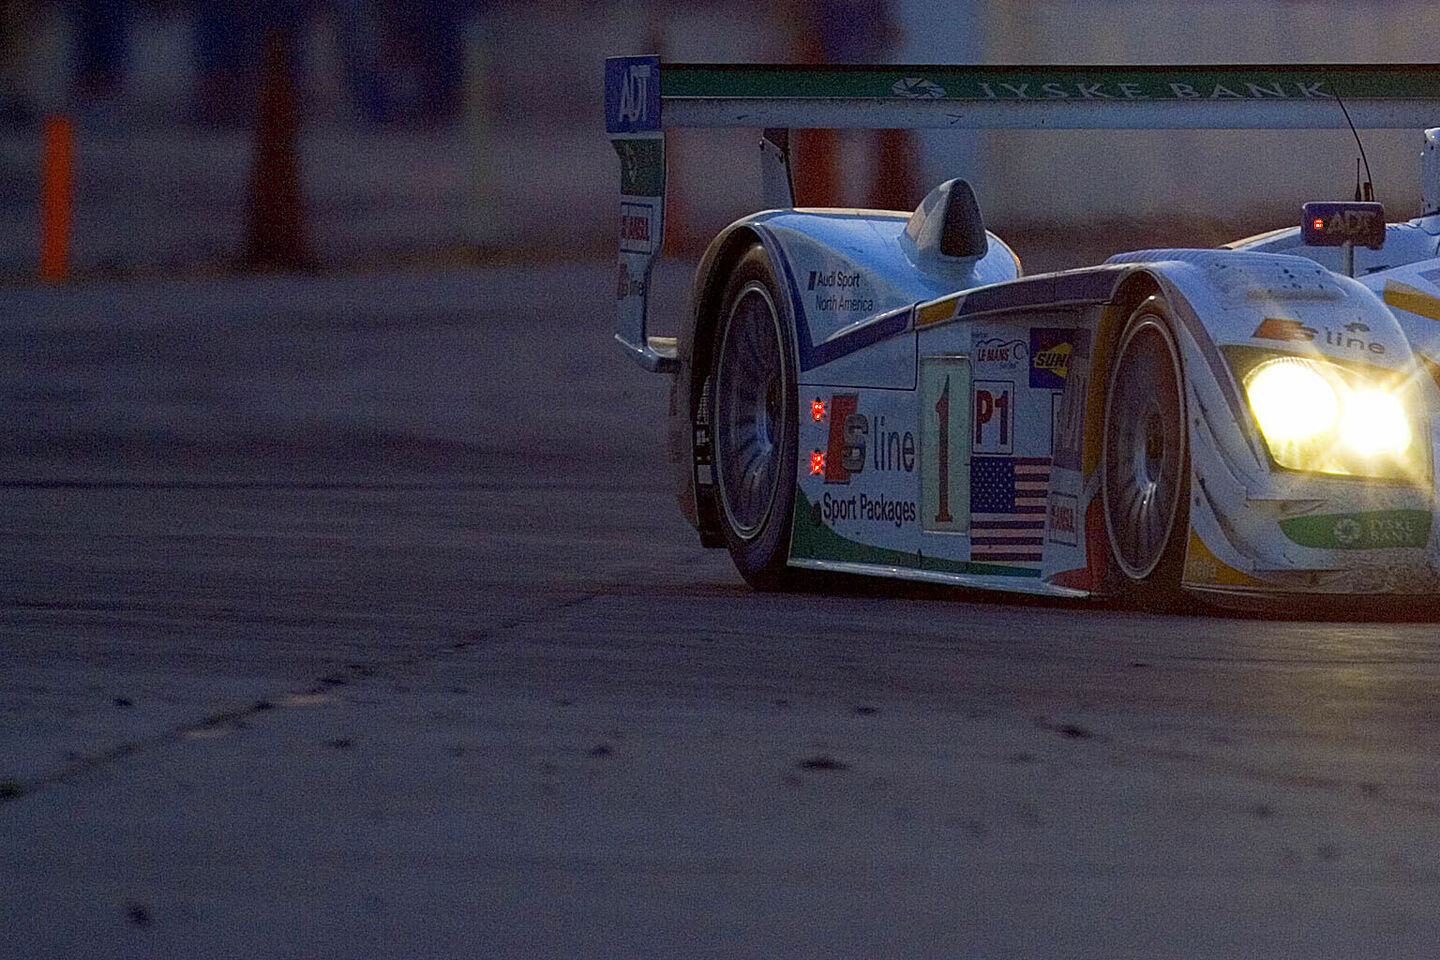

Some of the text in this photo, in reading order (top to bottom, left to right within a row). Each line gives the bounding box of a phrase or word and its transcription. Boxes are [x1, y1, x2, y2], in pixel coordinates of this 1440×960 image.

[618, 64, 651, 122] ADT
[977, 82, 1336, 99] JYSKE BANK
[816, 270, 860, 290] Audi Sport
[816, 295, 874, 312] North America
[1325, 326, 1386, 354] line
[976, 390, 1009, 445] P1
[873, 415, 915, 472] line
[934, 374, 954, 523] 1
[823, 492, 916, 527] Sport Packages
